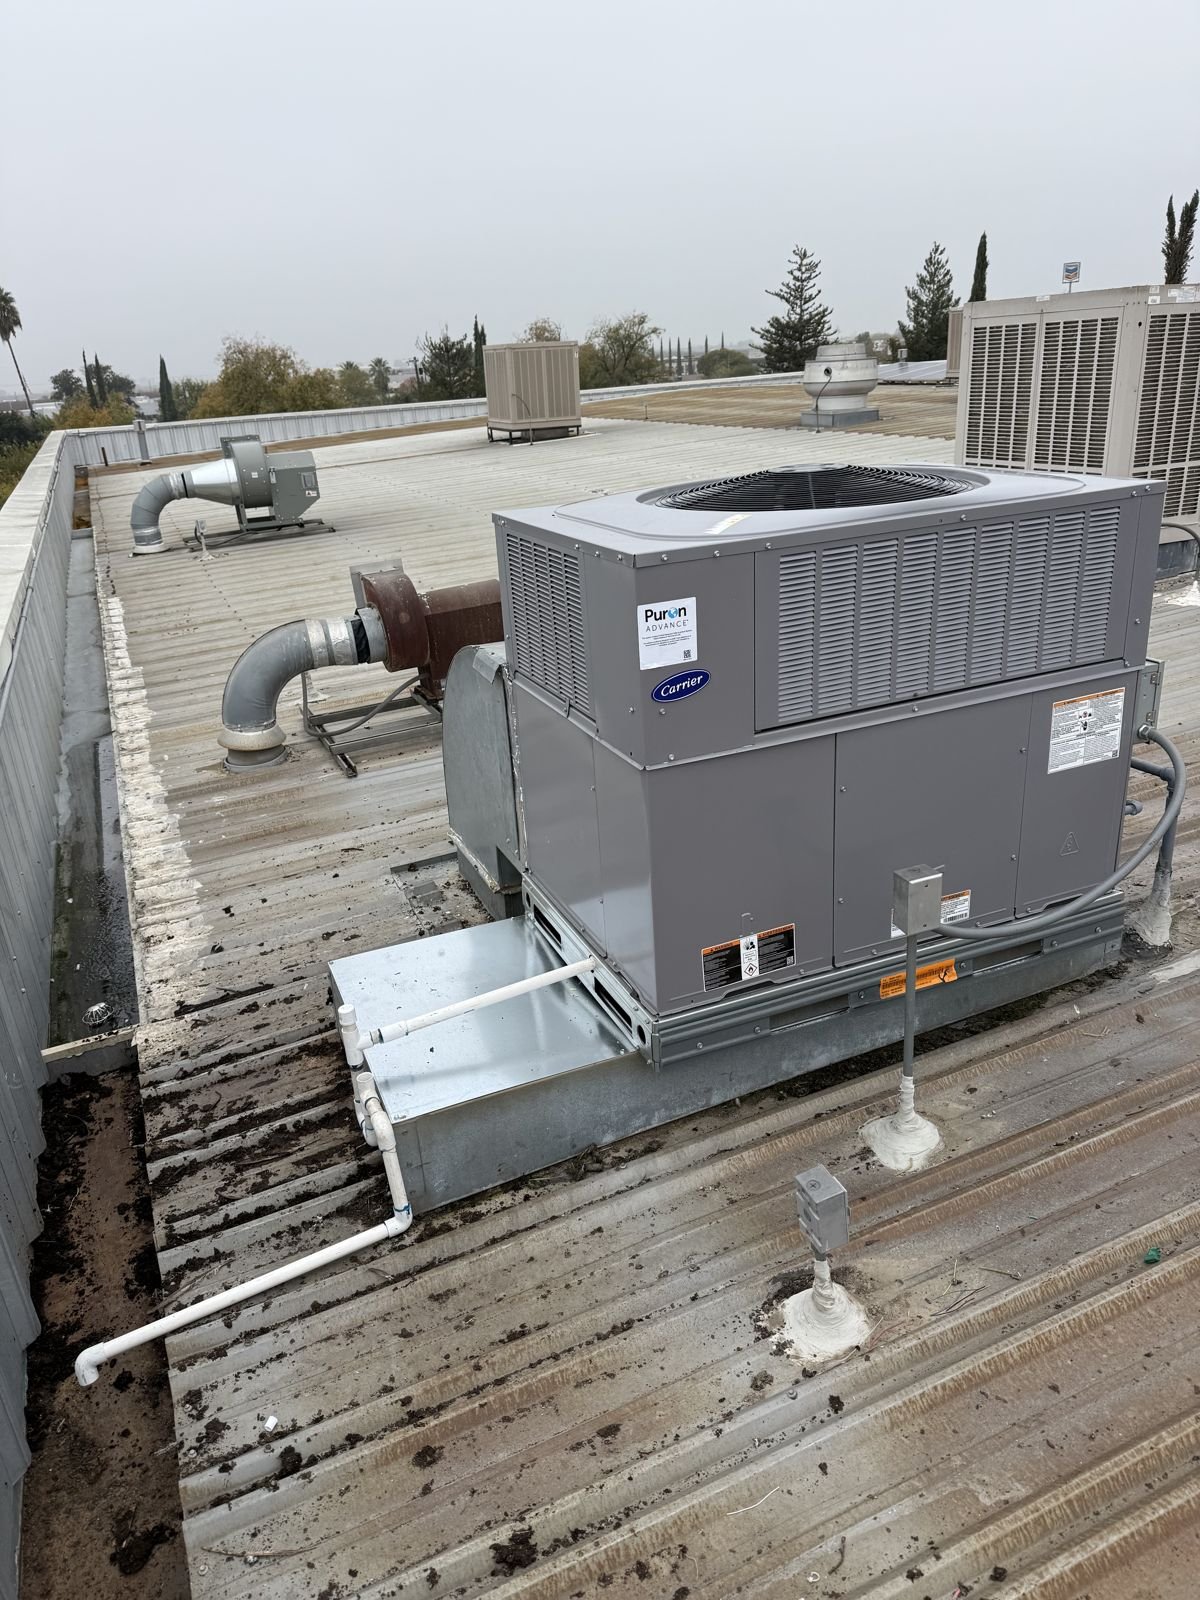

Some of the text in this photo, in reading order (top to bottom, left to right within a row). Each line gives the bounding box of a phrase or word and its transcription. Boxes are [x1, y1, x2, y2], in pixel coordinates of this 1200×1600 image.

[645, 606, 686, 622] Puron
[645, 619, 688, 633] ADVANCE
[660, 675, 703, 696] Carrier
